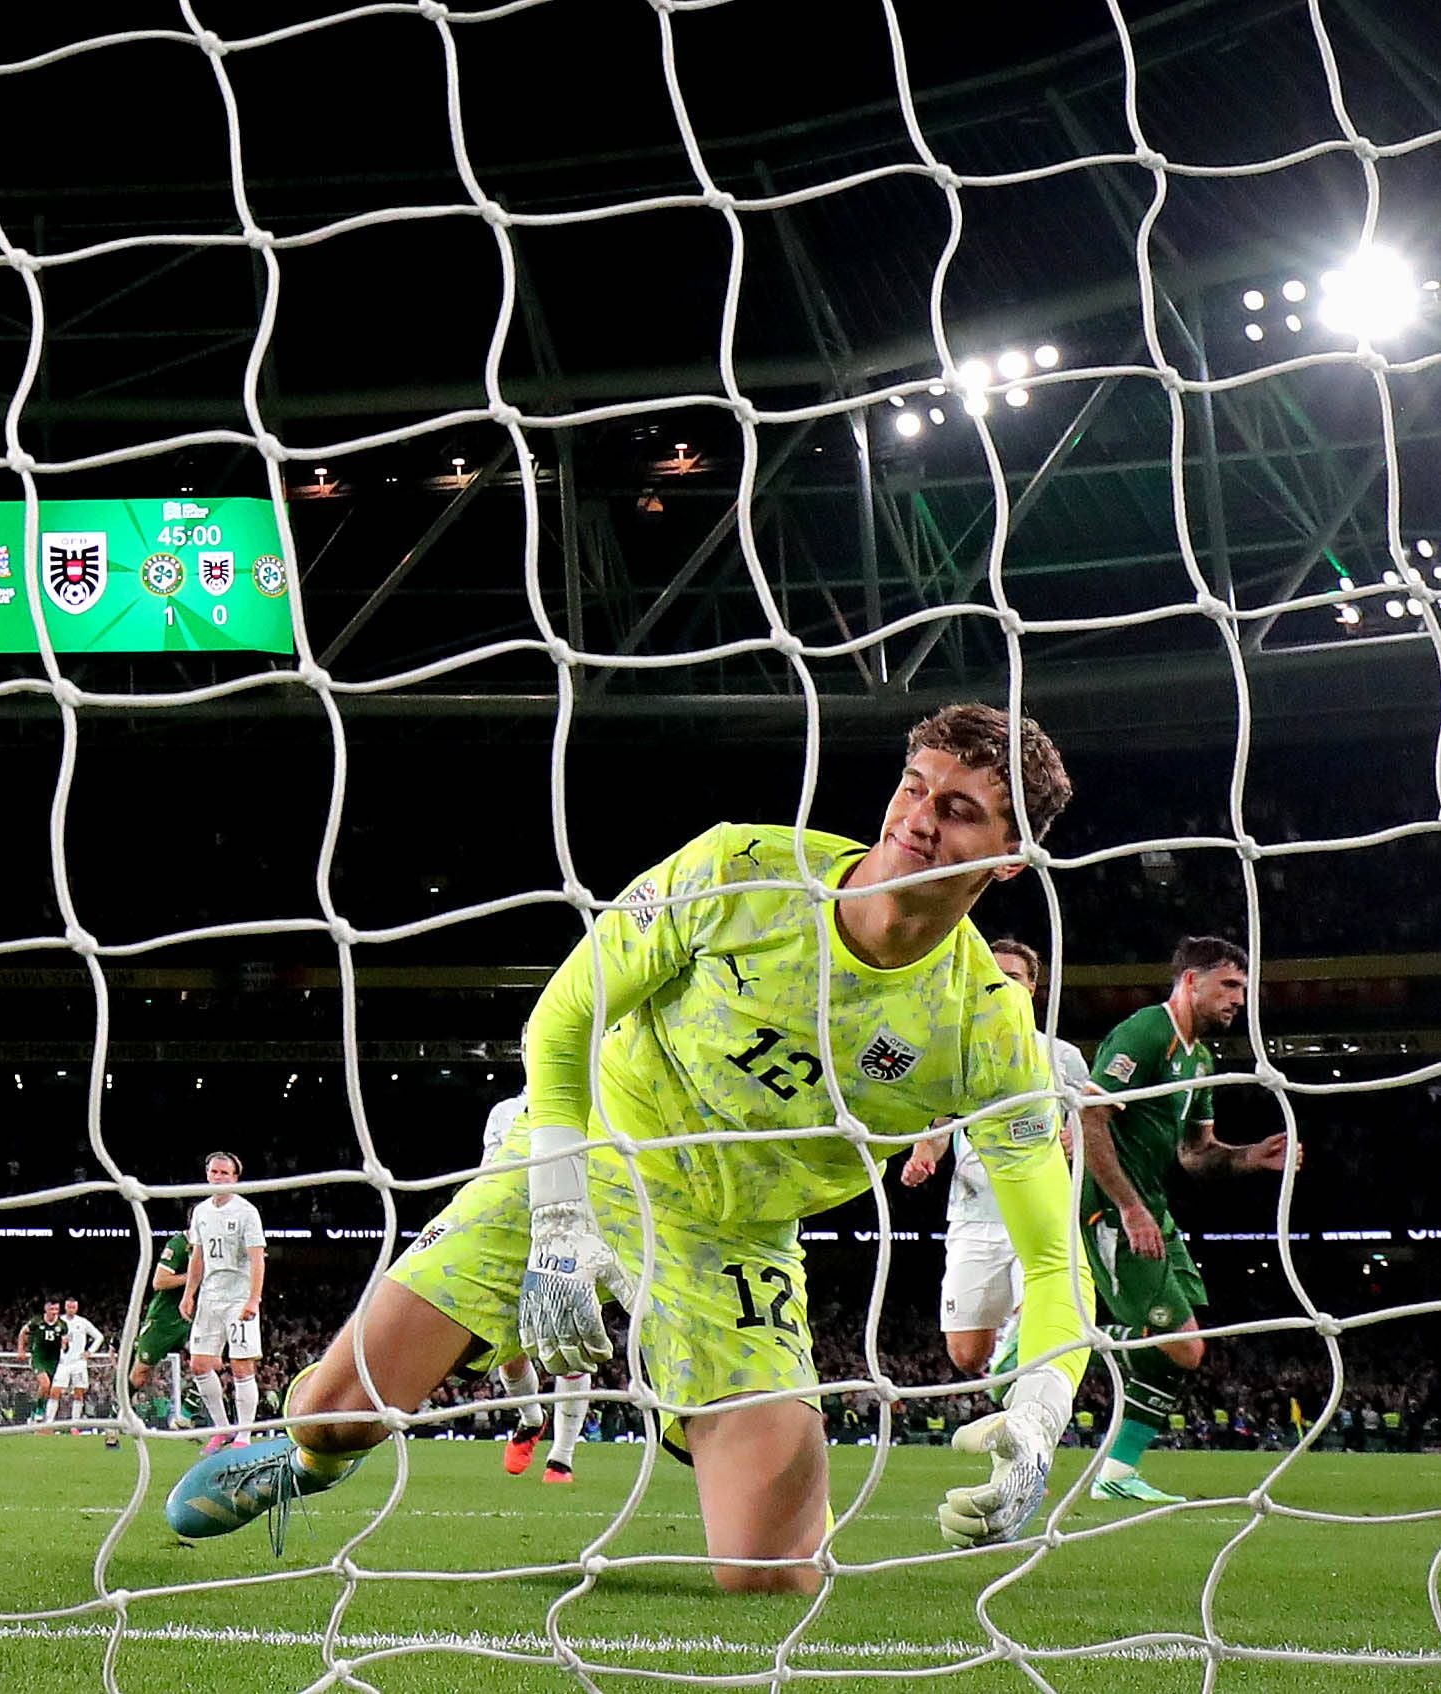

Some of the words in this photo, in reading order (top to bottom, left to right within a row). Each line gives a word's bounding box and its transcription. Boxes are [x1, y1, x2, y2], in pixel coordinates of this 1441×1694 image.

[157, 525, 221, 546] 45:00
[164, 606, 175, 626] 1
[212, 605, 228, 626] 0
[724, 1027, 824, 1101] 12
[86, 1228, 131, 1238] CASTORE
[344, 1229, 384, 1239] CASTOR
[209, 1238, 224, 1259] 21
[721, 1263, 800, 1337] 12
[44, 1329, 56, 1342] 15
[230, 1323, 246, 1344] 21
